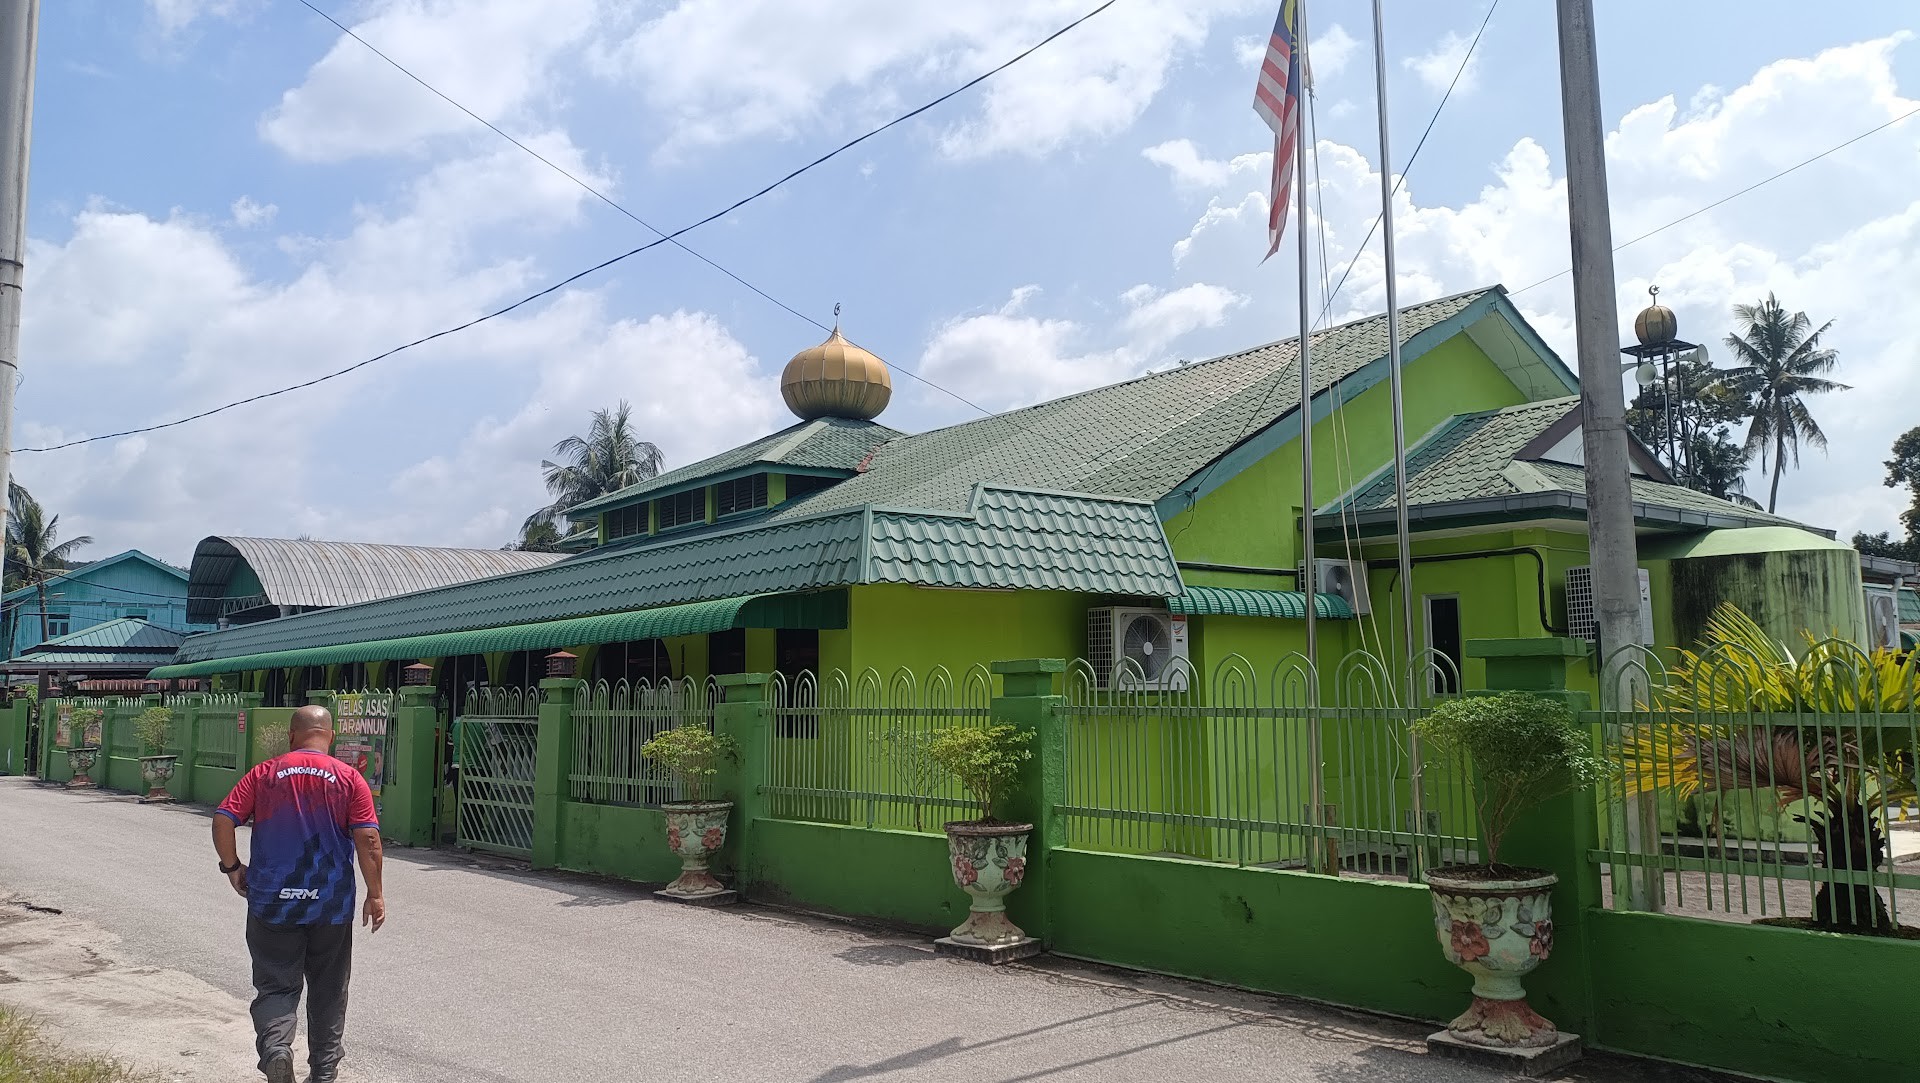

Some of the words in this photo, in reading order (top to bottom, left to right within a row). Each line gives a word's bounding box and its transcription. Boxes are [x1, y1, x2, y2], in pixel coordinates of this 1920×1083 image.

[338, 699, 363, 717] KELAS
[365, 699, 387, 717] ASAS
[337, 719, 387, 735] TARANNUM
[277, 766, 337, 784] BUNGARAYA
